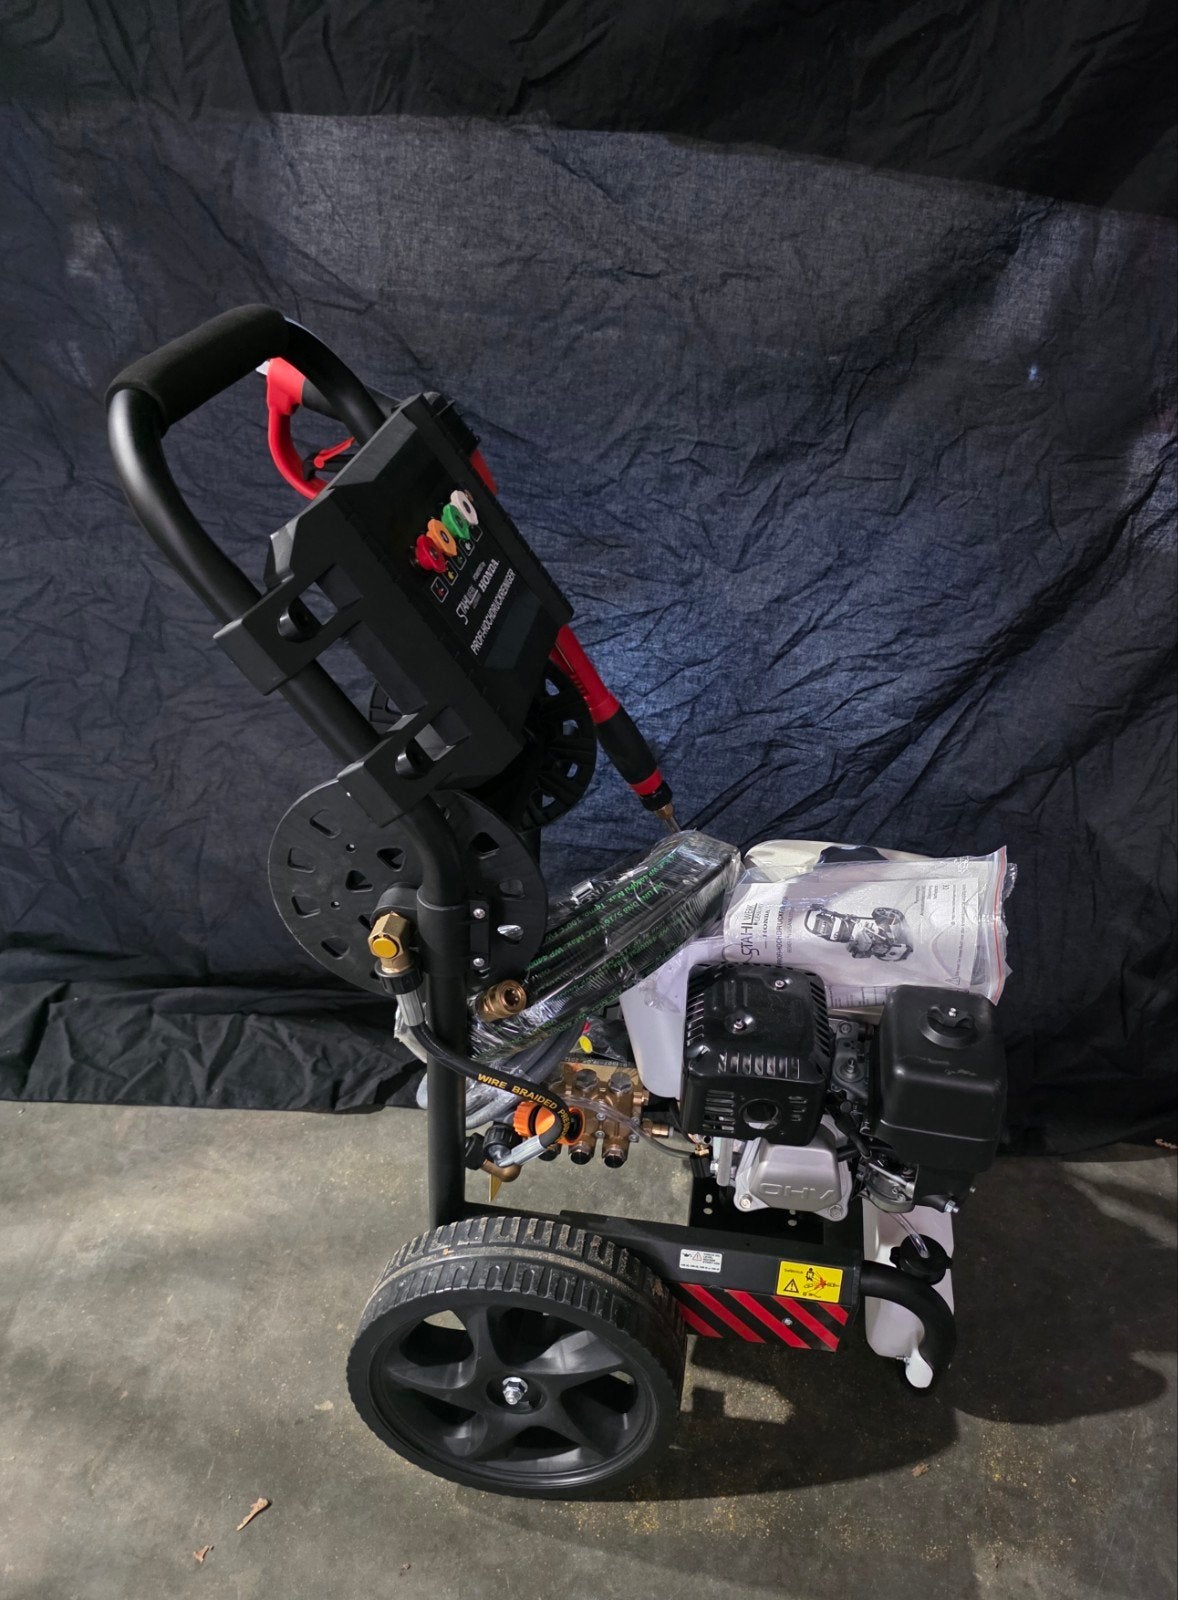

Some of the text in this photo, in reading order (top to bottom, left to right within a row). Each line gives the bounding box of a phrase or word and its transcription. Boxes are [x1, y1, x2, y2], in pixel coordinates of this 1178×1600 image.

[478, 558, 499, 593] HONDA
[478, 1073, 507, 1090] WIRE
[511, 1085, 558, 1111] BRAIDED
